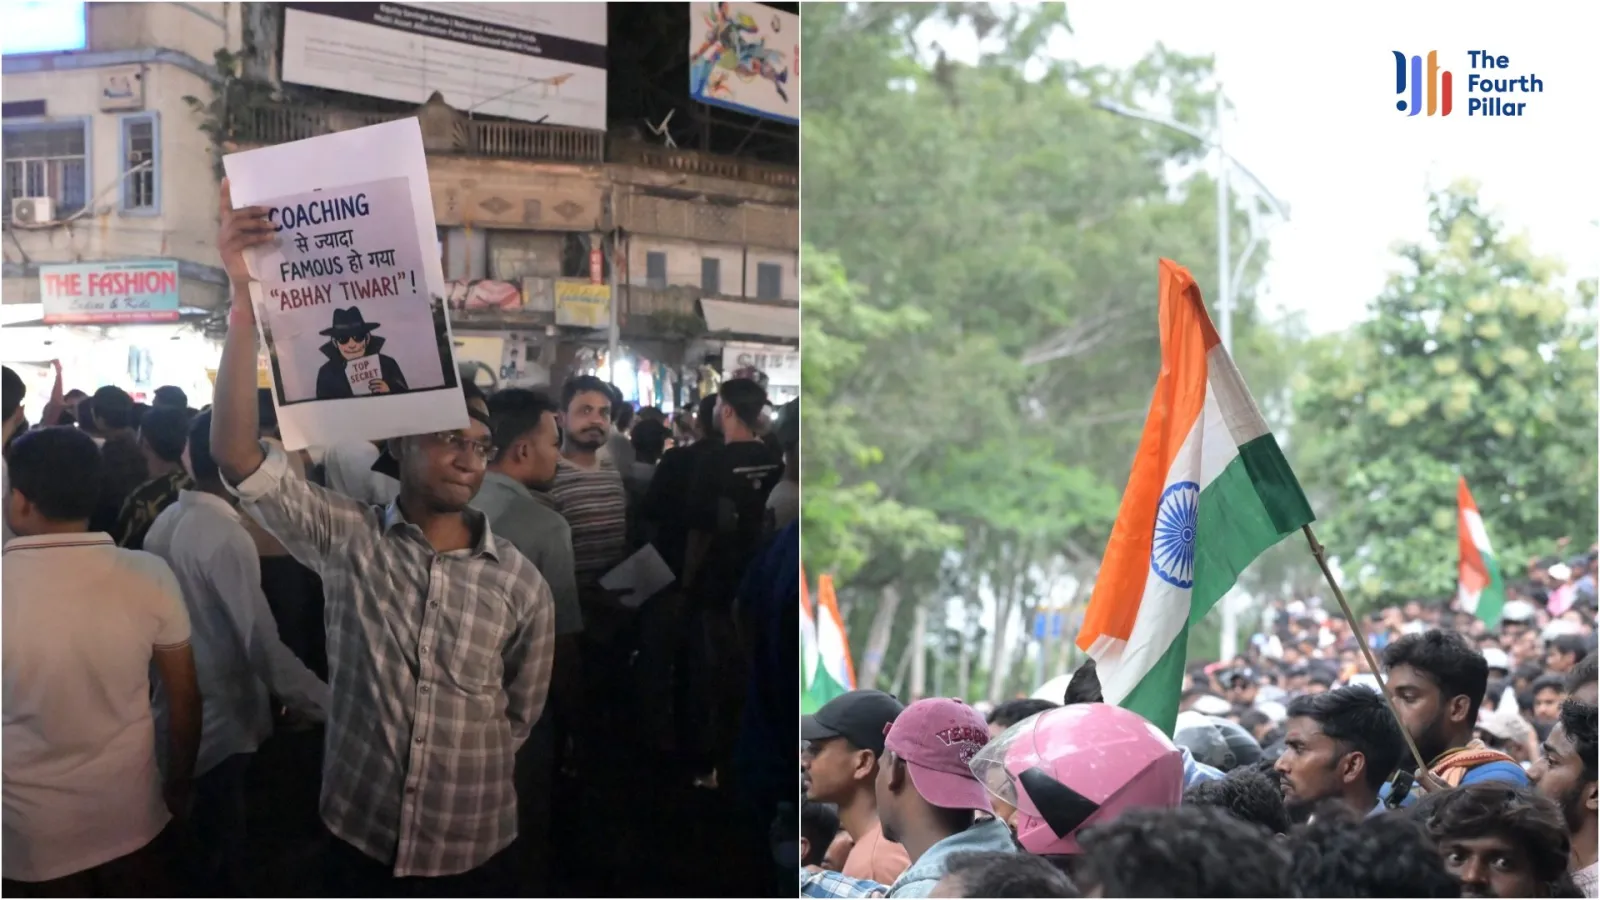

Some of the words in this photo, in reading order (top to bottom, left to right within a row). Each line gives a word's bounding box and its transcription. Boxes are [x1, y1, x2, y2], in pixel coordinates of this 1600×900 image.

[268, 193, 370, 232] COACHING
[294, 232, 309, 254] से
[314, 229, 354, 250] ज्यादा
[279, 256, 344, 283] FAMOUS
[347, 249, 364, 274] हो
[368, 249, 396, 268] गया
[44, 272, 82, 297] THE
[87, 270, 177, 297] FASHION
[350, 369, 379, 384] SECRET
[352, 360, 370, 372] TOP
